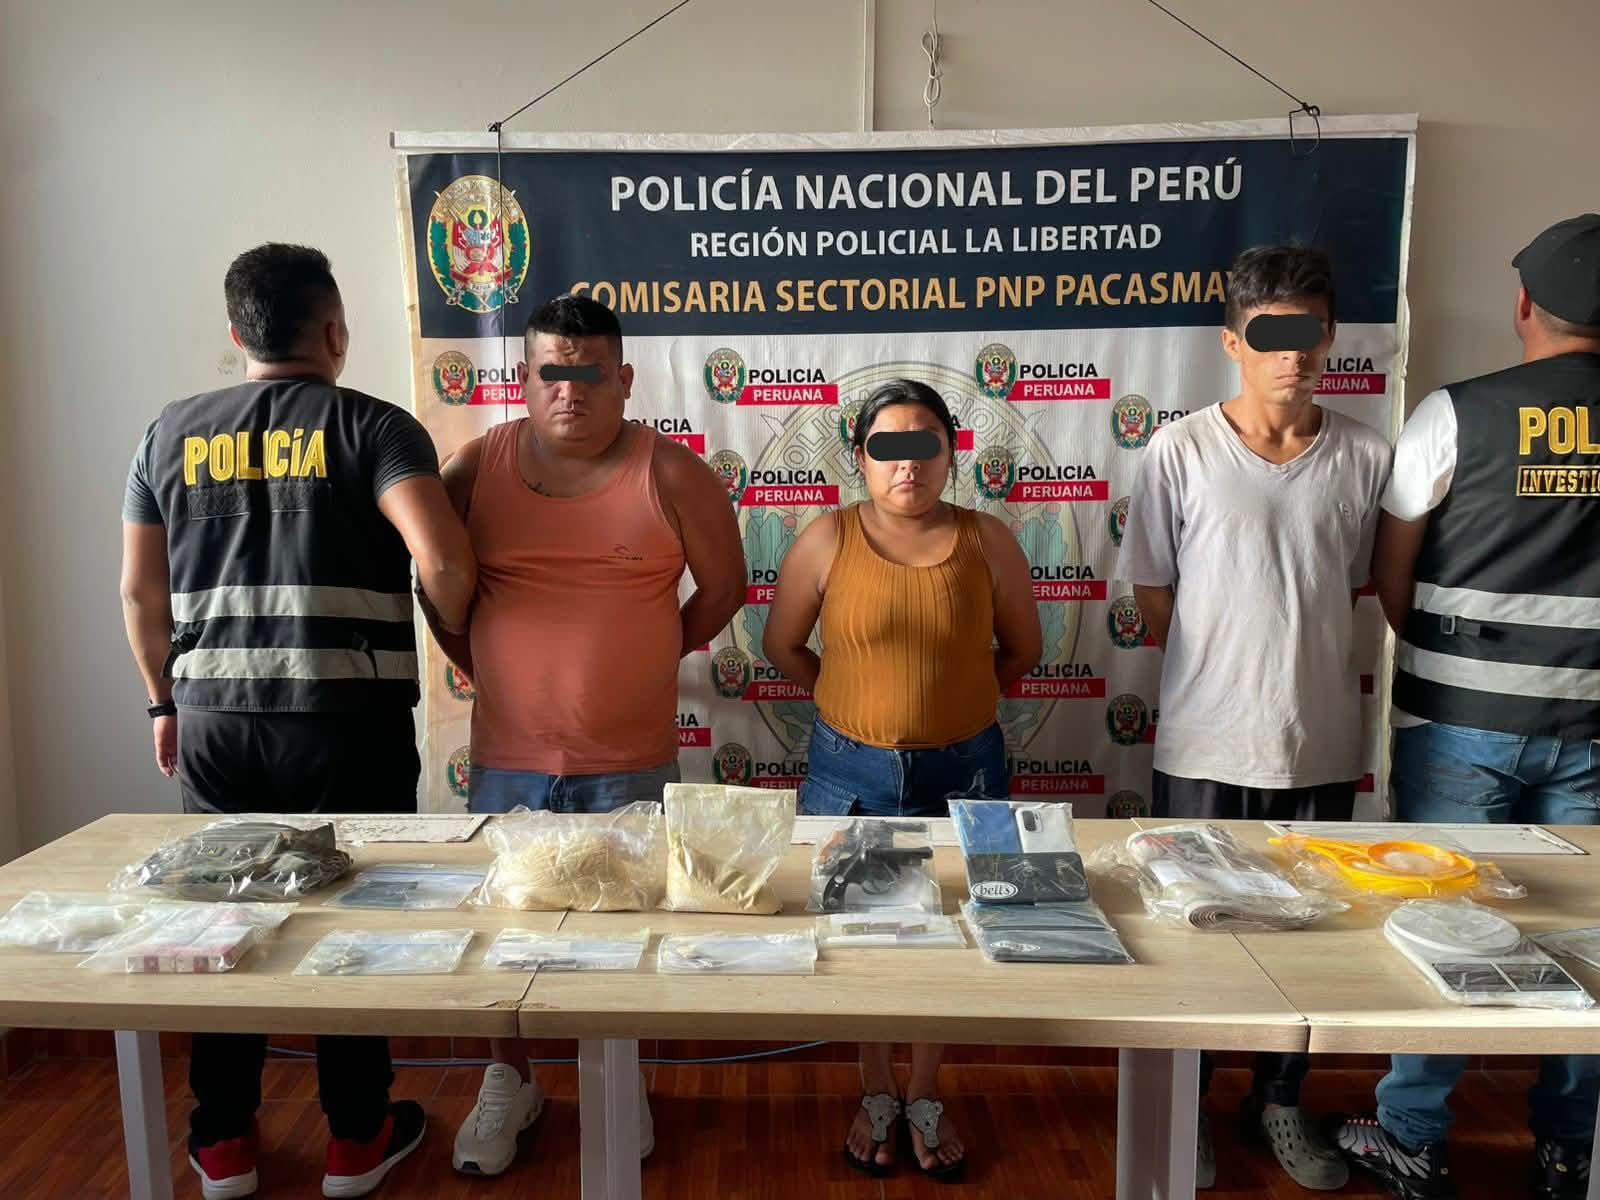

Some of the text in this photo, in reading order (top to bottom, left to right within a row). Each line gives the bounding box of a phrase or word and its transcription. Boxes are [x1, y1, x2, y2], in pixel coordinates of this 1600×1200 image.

[611, 157, 1242, 212] POLICÍA NACIONAL DEL PERÚ
[690, 223, 1162, 257] REGIÓN POLICIAL LA LIBERTAD
[776, 277, 966, 312] SECTORIAL
[976, 275, 1045, 308] PNP
[1019, 363, 1098, 379] POLICIA
[1326, 357, 1375, 372] LICIA
[477, 367, 517, 383] POLI
[749, 368, 826, 384] POLICIA
[753, 388, 824, 401] PERUANA
[1023, 383, 1096, 397] PERUANA
[1519, 406, 1600, 455] POL
[750, 470, 827, 485] POLICIA
[1018, 465, 1096, 480] POLICIA
[1522, 469, 1600, 493] INVESTI
[755, 488, 824, 502] PERUANA
[1022, 485, 1094, 498] PERUANA
[1030, 565, 1095, 580] OLICIA
[1032, 585, 1092, 597] ERUANA
[1030, 663, 1093, 678] OLICIA
[758, 684, 811, 697] PERUA
[1021, 685, 1091, 696] PERUANA
[755, 762, 809, 776] POLIC
[1016, 760, 1093, 775] POLICIA
[1021, 781, 1090, 792] PERUANA
